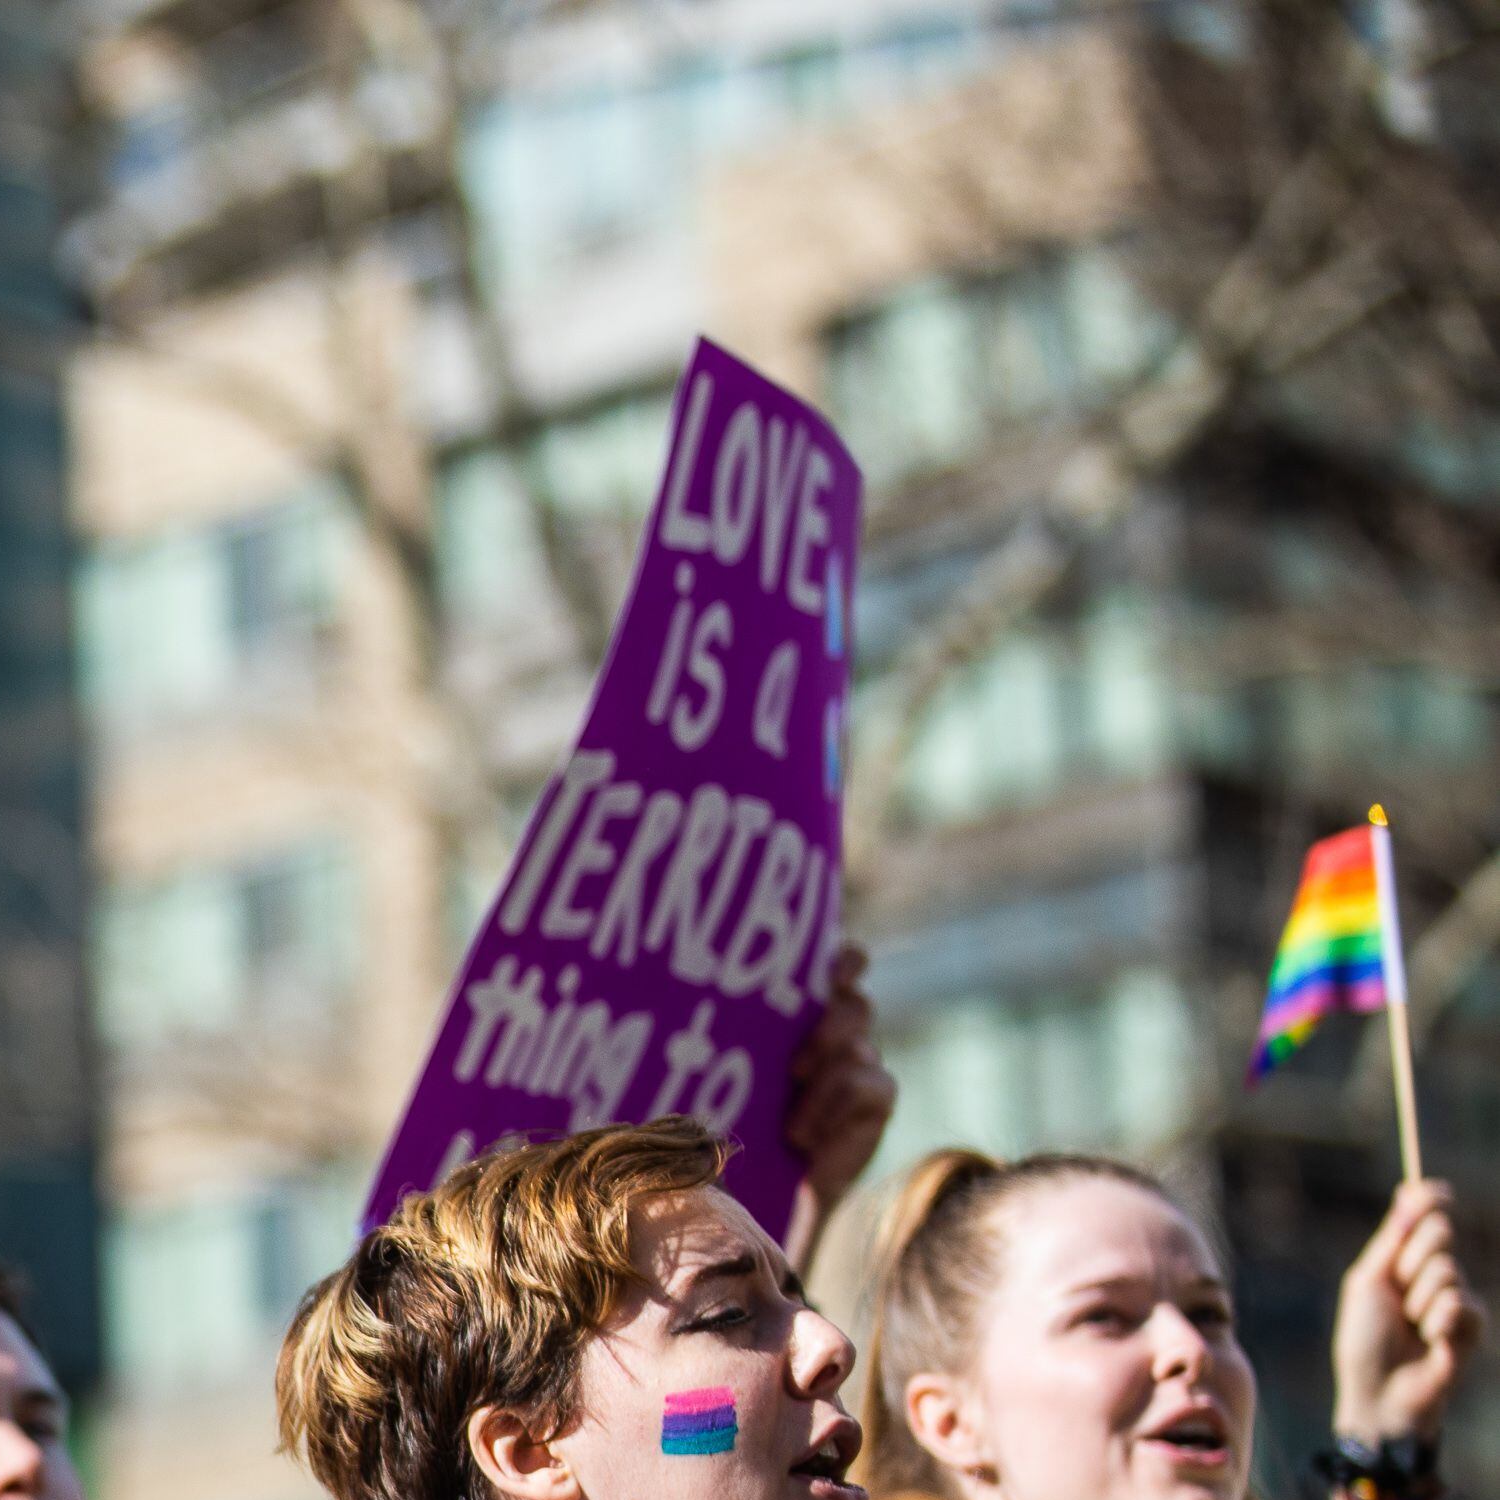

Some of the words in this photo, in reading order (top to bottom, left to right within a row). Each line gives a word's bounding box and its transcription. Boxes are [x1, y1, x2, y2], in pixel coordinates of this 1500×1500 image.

[659, 369, 834, 616] LOVE
[646, 560, 733, 752] is
[453, 955, 655, 1134] thing
